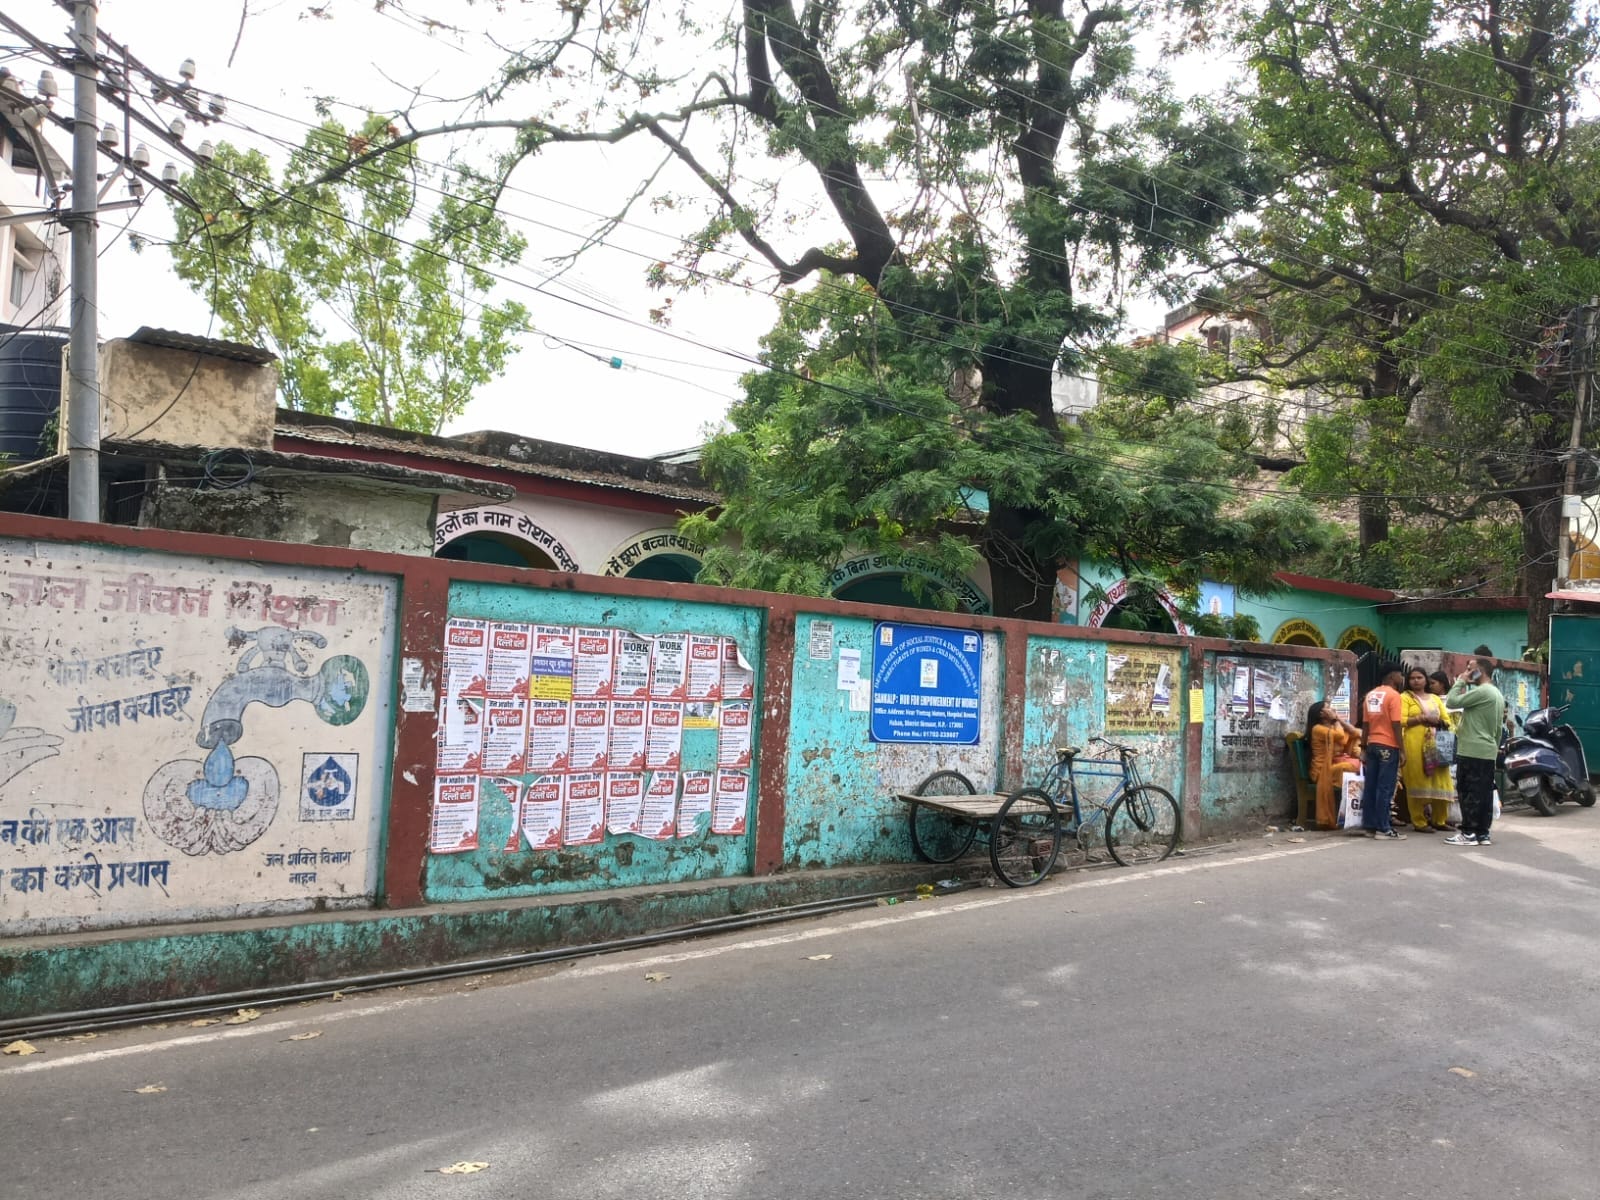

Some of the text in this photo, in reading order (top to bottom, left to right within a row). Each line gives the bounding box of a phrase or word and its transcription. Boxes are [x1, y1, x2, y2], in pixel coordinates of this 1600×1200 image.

[462, 511, 479, 528] का
[484, 511, 513, 530] नाम
[517, 515, 556, 550] रोशन
[641, 534, 669, 553] बच्चा
[846, 559, 870, 576] बिना
[9, 572, 89, 610] जल
[99, 572, 212, 618] जीवन
[623, 642, 649, 652] WORK
[659, 641, 683, 651] WORK
[64, 696, 121, 733] जीवन
[263, 847, 353, 869] जल शक्ति विभाग
[107, 860, 171, 898] प्रयास
[289, 872, 317, 888] नाहन
